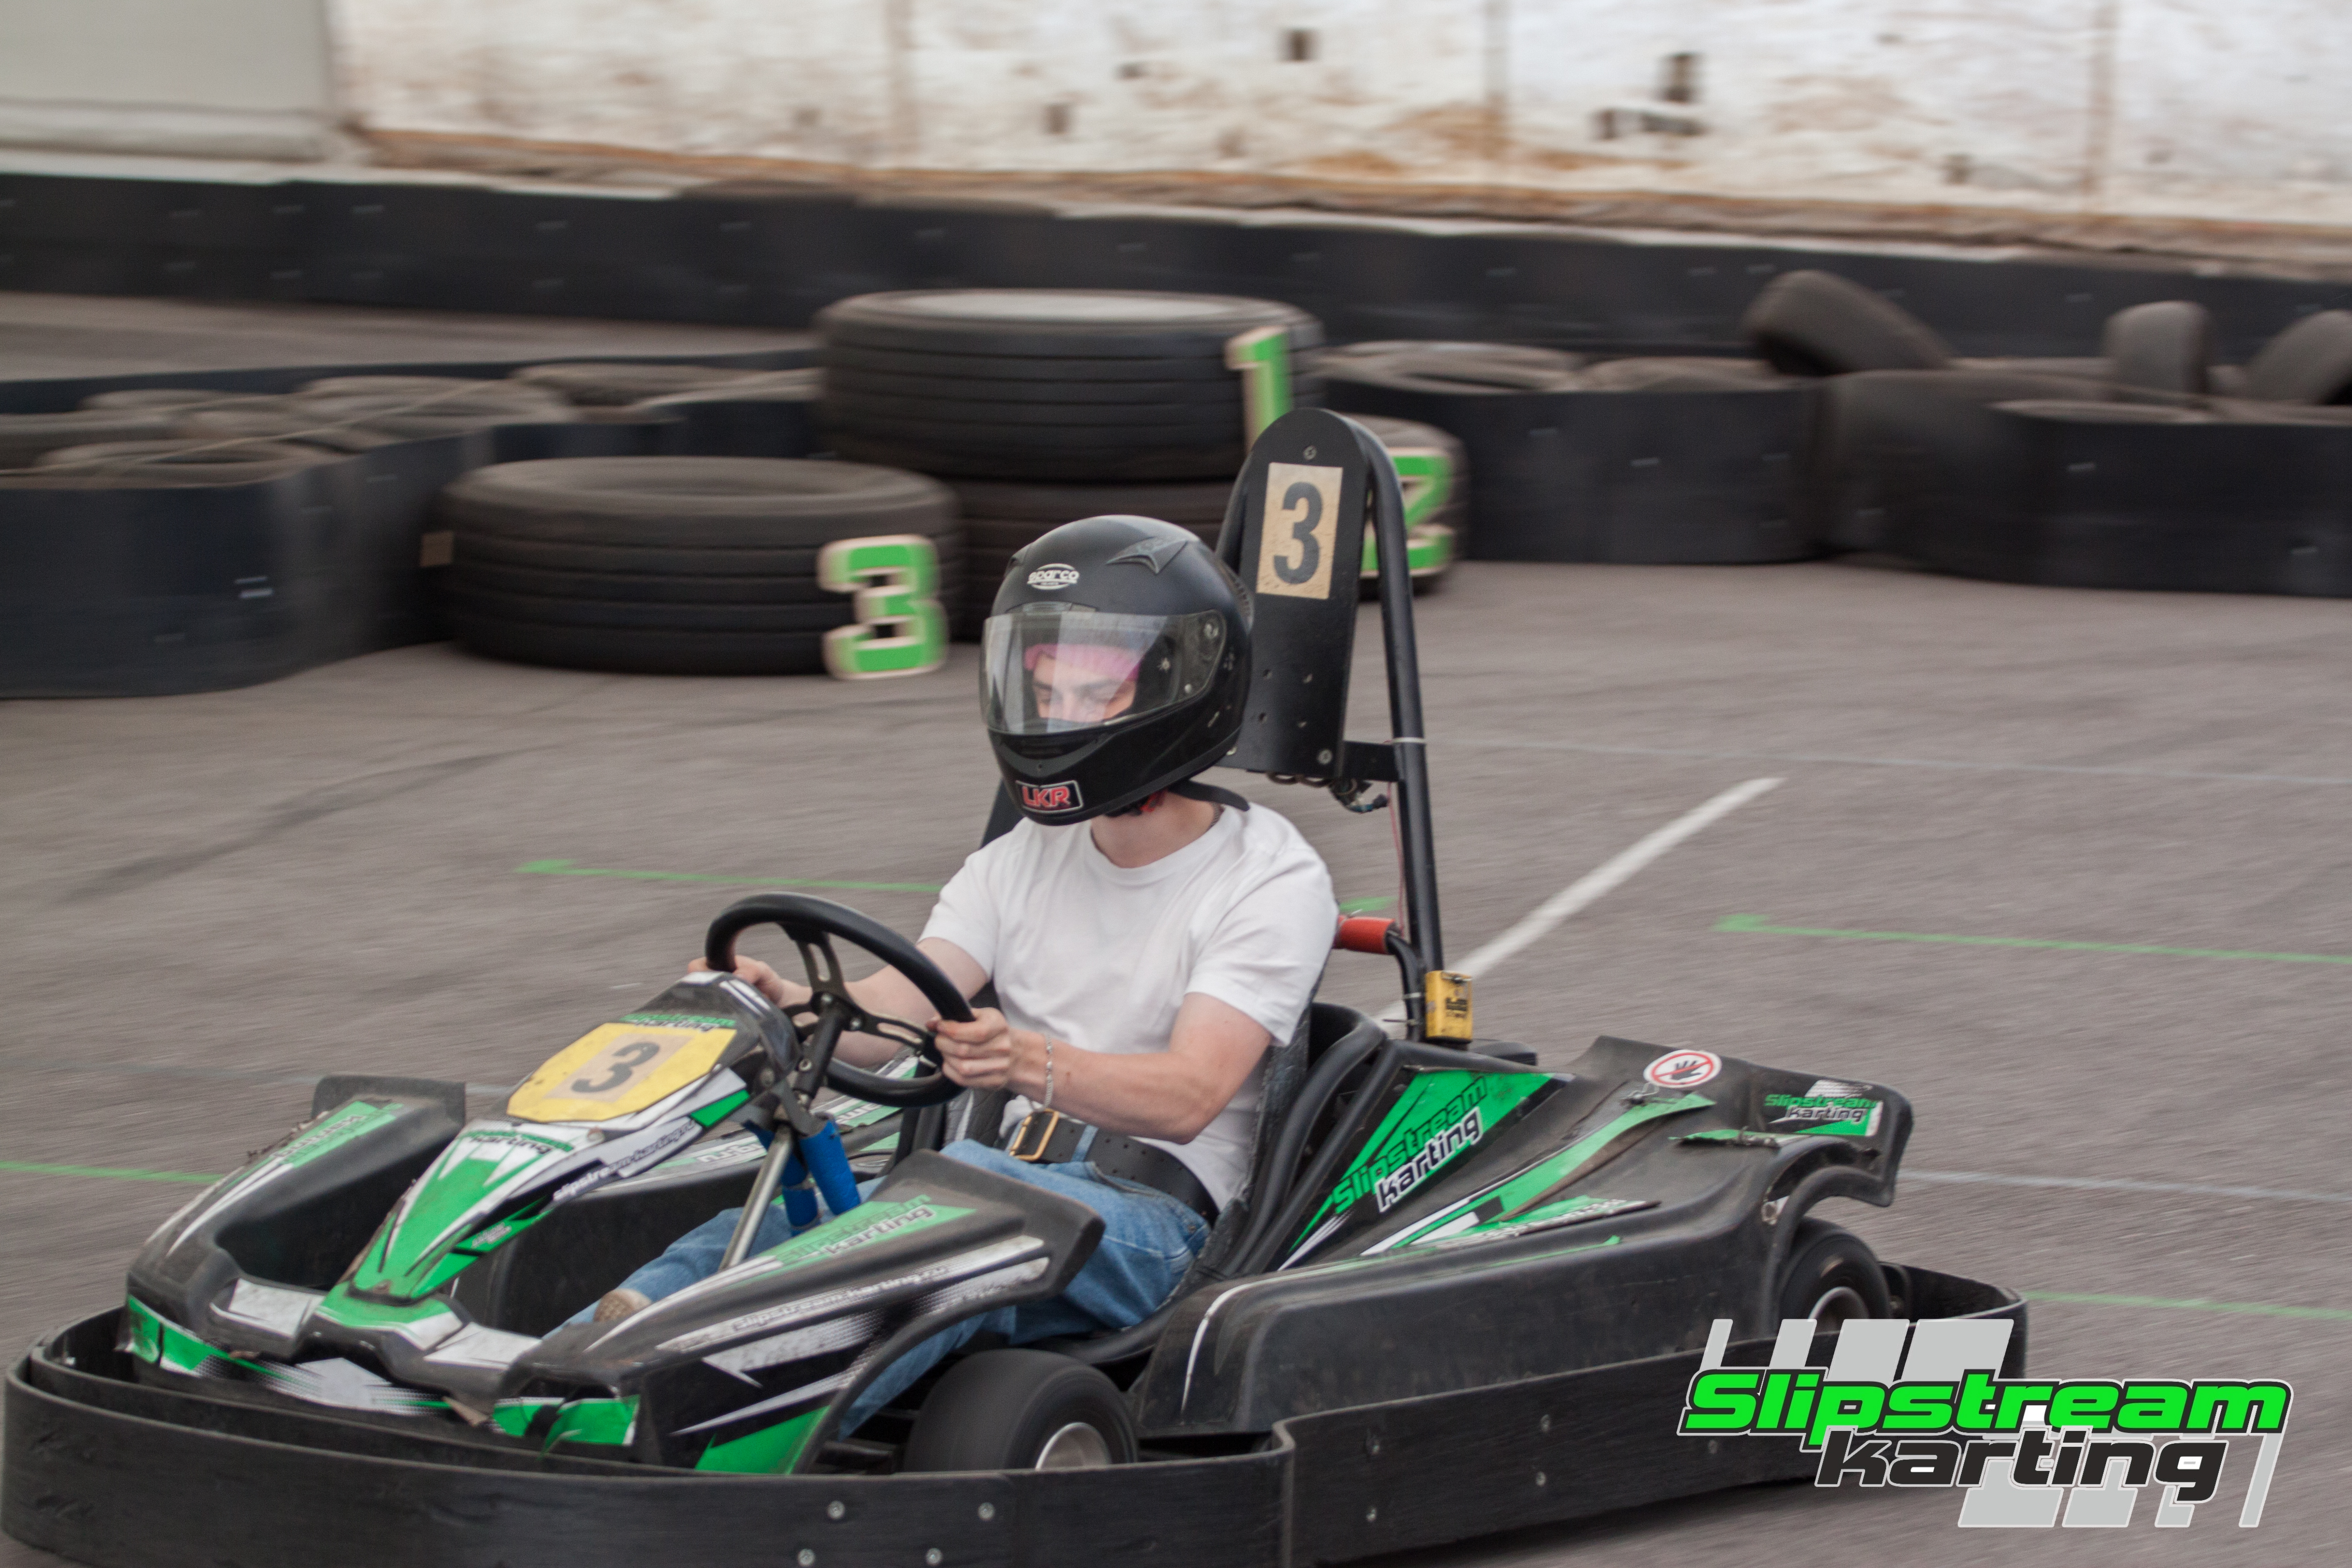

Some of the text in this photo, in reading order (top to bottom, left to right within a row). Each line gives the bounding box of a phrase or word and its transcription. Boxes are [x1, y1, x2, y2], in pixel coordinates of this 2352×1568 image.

[1225, 325, 1293, 453] 1
[1273, 481, 1323, 585] 3
[817, 534, 947, 680] 3
[1022, 785, 1071, 807] LKR
[570, 1042, 660, 1093] 3
[1786, 1104, 1867, 1123] karting
[1332, 1075, 1487, 1214] Slipstream
[1375, 1106, 1484, 1213] karting
[819, 1204, 936, 1257] karting
